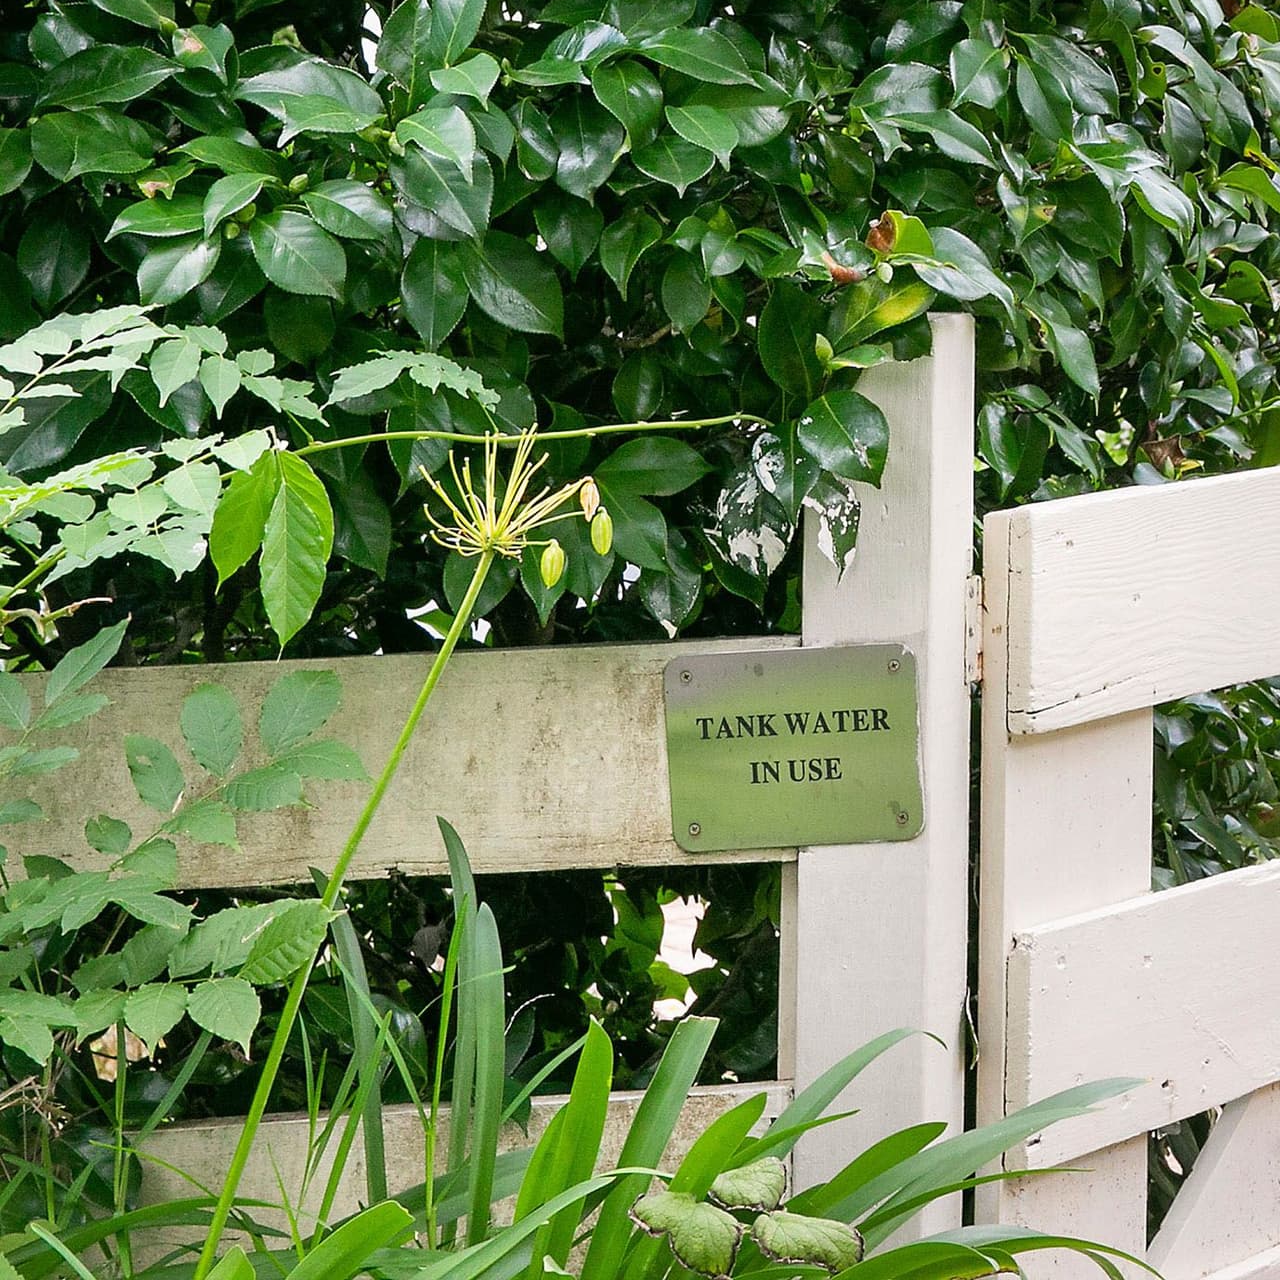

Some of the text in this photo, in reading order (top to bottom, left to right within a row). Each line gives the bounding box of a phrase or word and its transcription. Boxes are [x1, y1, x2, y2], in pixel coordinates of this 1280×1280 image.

[696, 708, 891, 740] TANK WATER
[750, 757, 843, 785] IN USE
